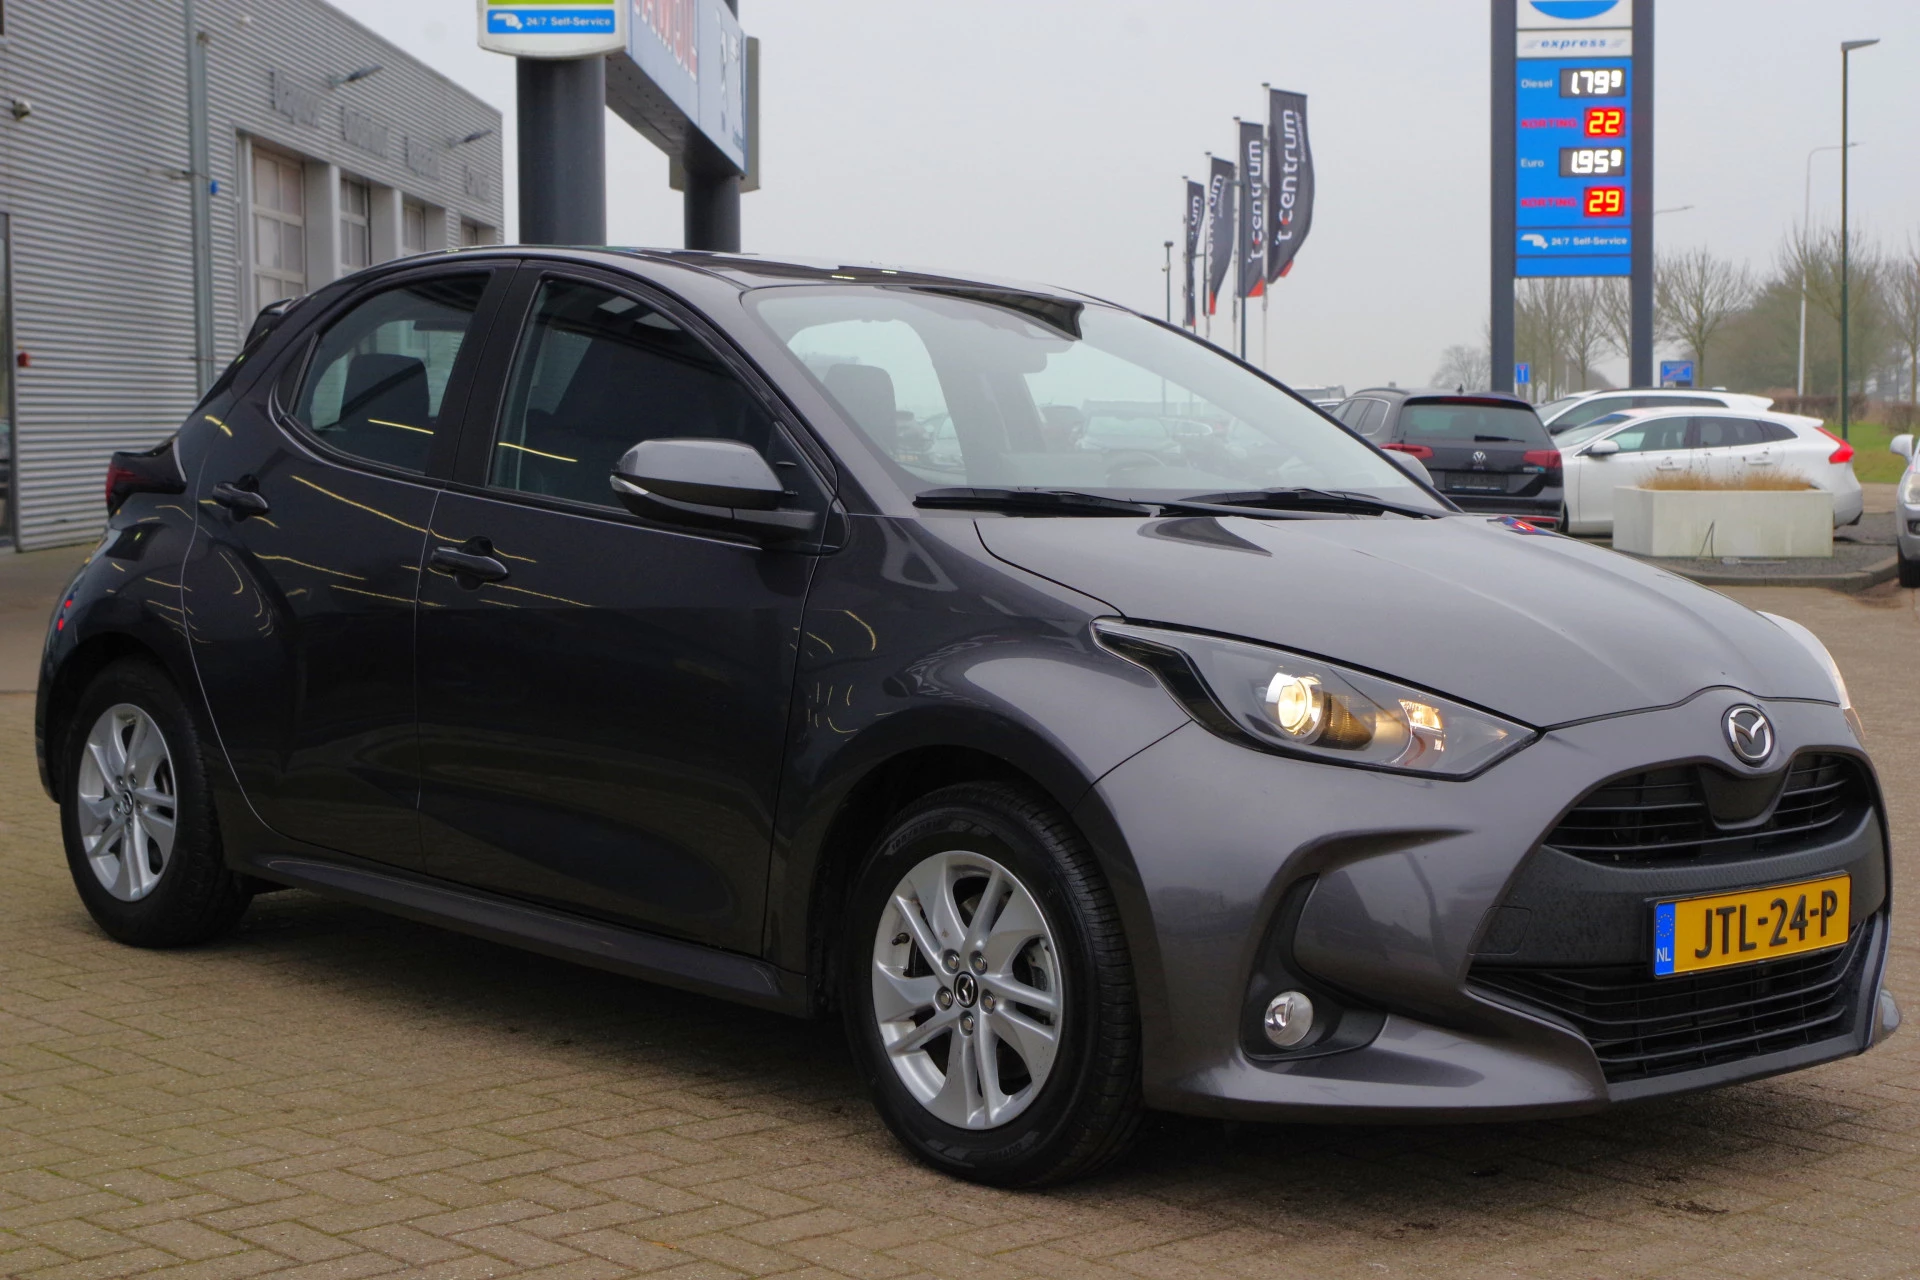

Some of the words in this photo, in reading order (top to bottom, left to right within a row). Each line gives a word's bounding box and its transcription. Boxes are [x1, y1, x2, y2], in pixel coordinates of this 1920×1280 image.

[551, 16, 611, 27] Self-Service
[1540, 39, 1607, 50] express
[1521, 78, 1553, 89] Diesel
[1589, 111, 1620, 134] 22
[1278, 109, 1299, 226] centrum
[1520, 157, 1545, 168] Euro
[1248, 139, 1264, 245] centrum
[1588, 190, 1620, 213] 29
[1573, 237, 1628, 247] Self-Service
[1694, 889, 1839, 959] JTL-24-P
[1656, 948, 1672, 963] NL
